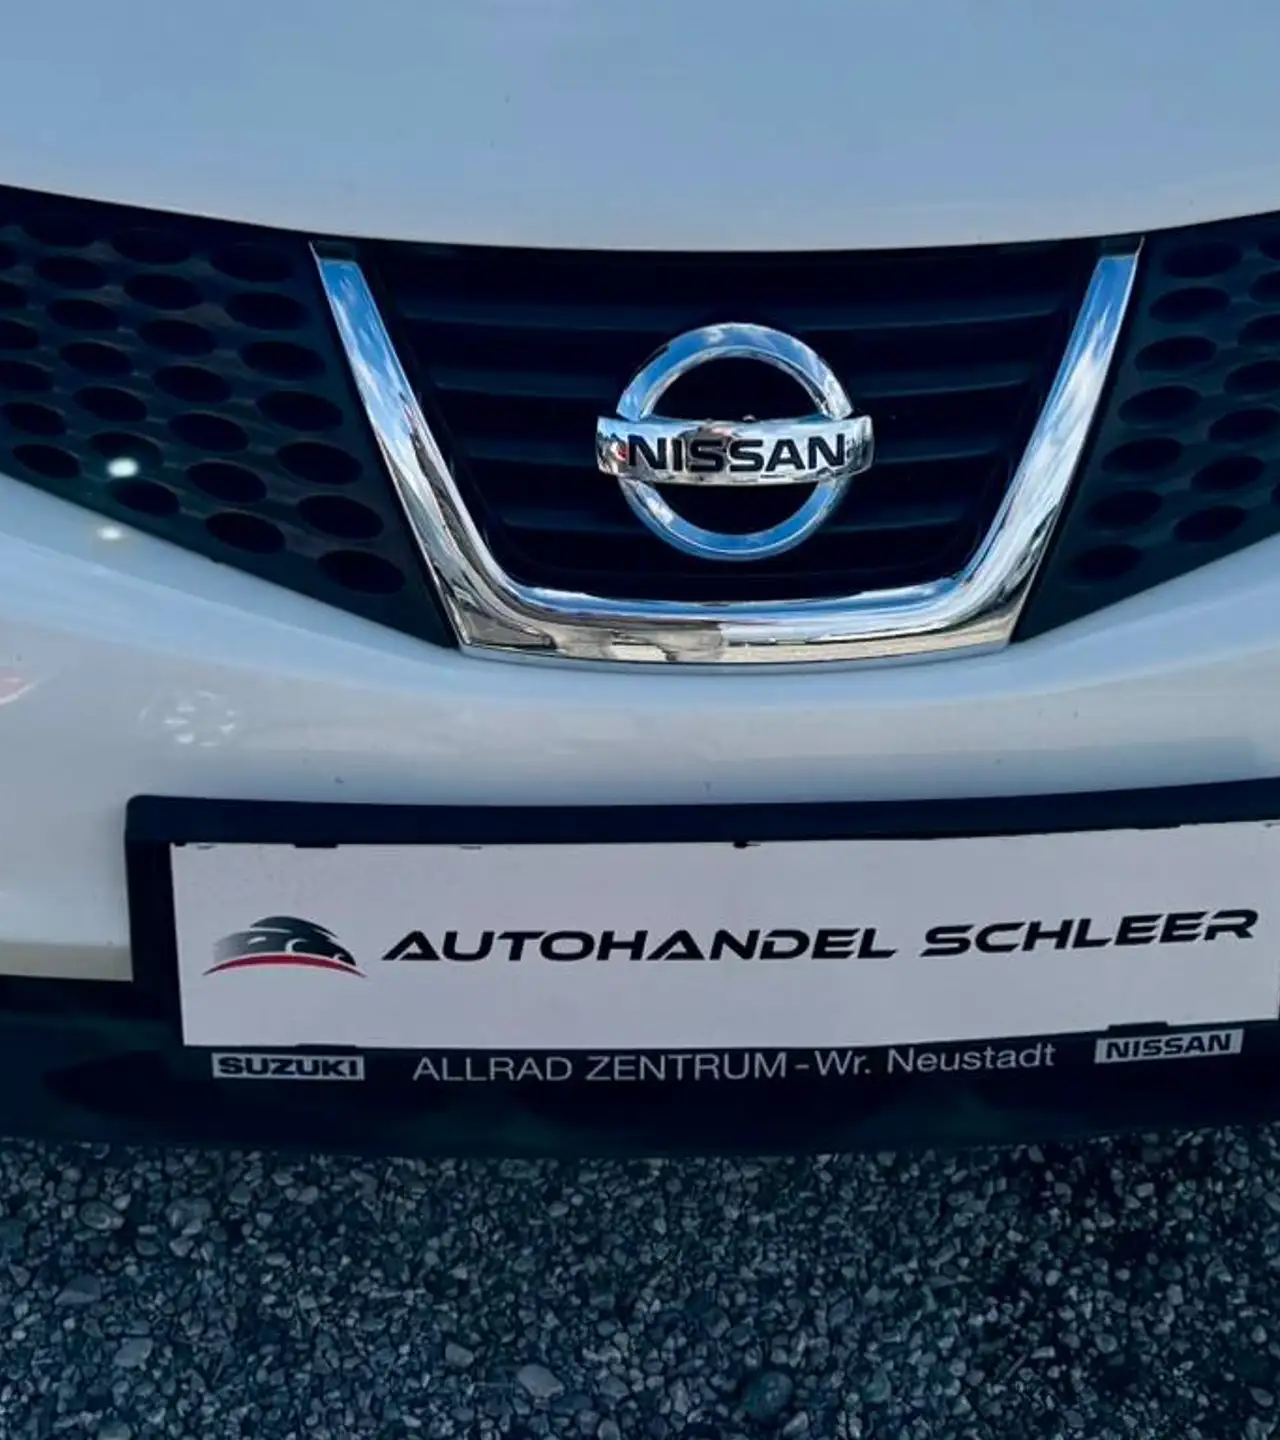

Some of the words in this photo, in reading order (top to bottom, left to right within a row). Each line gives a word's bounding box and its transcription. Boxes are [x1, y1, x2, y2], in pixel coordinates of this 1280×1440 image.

[626, 433, 845, 473] NISSAN
[380, 927, 897, 962] AUTOHANDEL
[919, 908, 1259, 958] SCHLEER
[218, 1055, 360, 1079] SUZUKI
[412, 1056, 574, 1083] ALLRAD
[887, 1041, 1057, 1075] Neustadt
[1104, 1032, 1233, 1062] NISSAN
